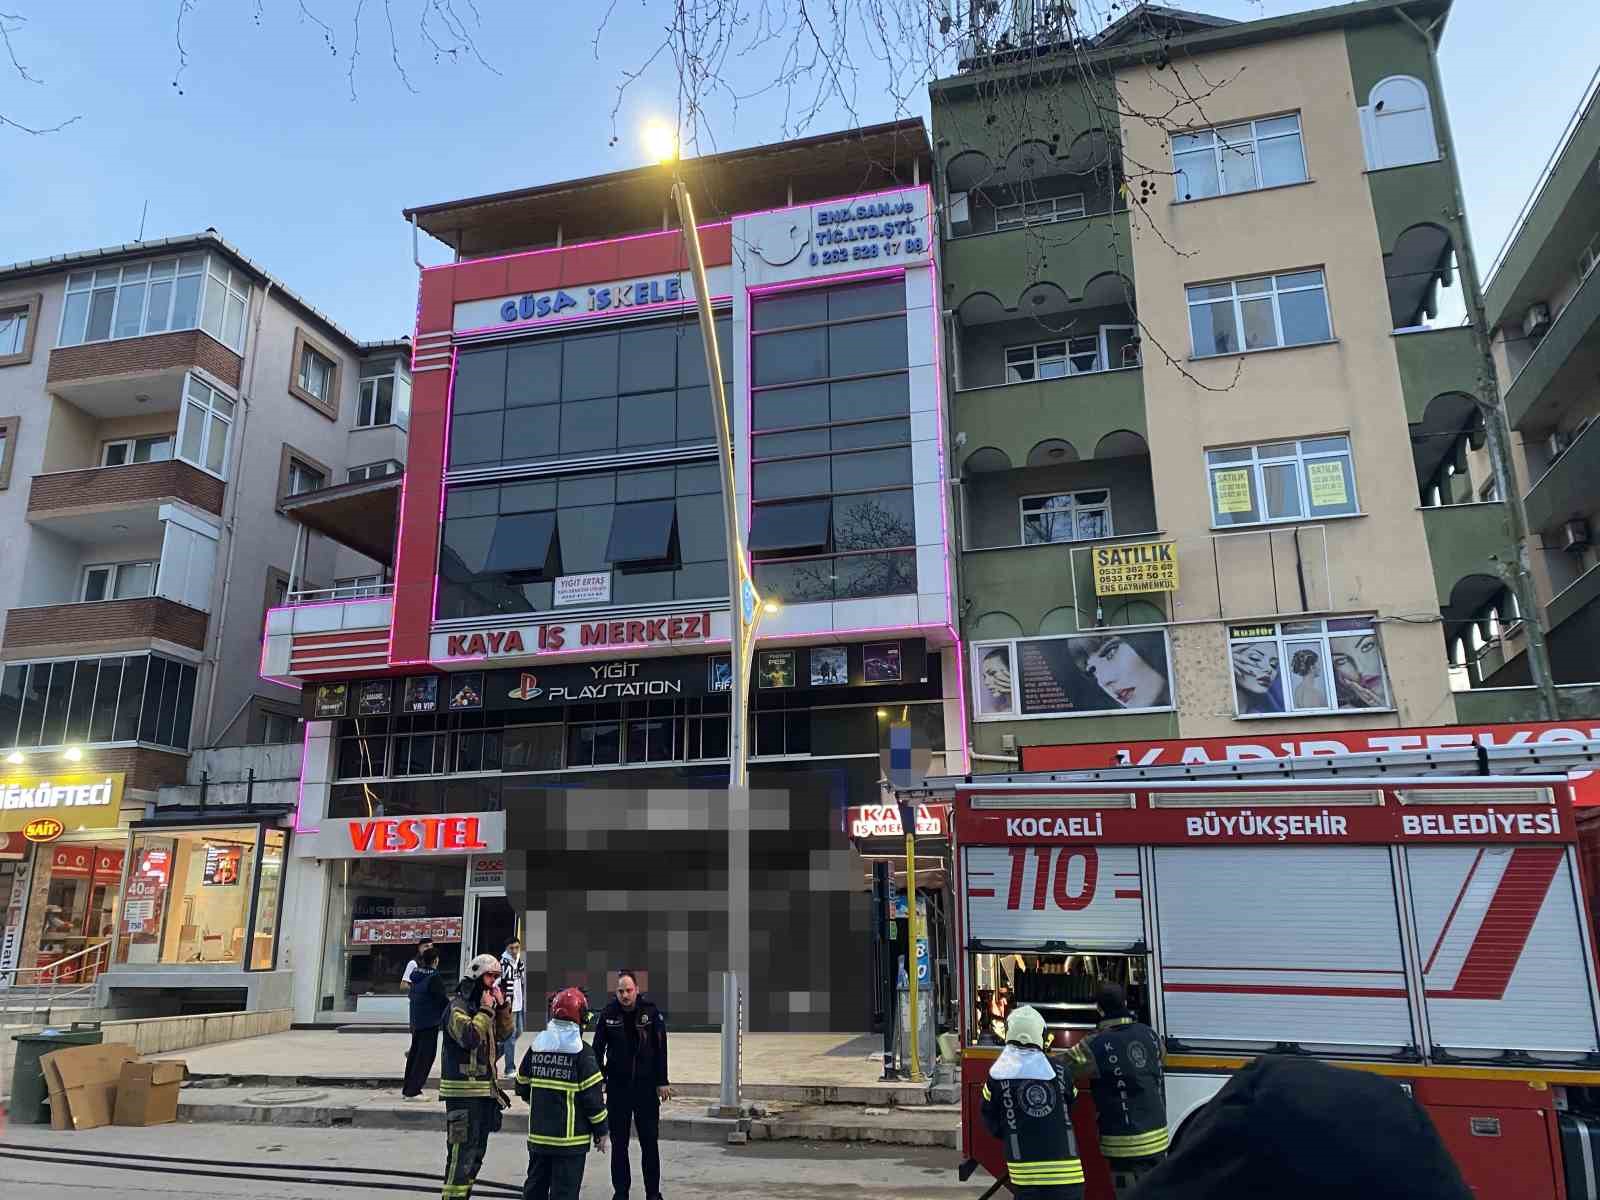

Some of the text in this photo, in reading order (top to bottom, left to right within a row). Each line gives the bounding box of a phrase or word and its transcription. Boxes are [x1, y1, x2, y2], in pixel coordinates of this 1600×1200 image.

[809, 252, 819, 267] 0
[822, 247, 848, 265] 262
[884, 240, 902, 256] 17
[500, 290, 577, 322] GÜSA
[1098, 543, 1172, 566] SATILIK
[447, 630, 524, 656] KAYA
[580, 610, 711, 646] MERKEZİ
[591, 661, 640, 679] YİĞİT
[549, 679, 681, 700] PLAYSTATION
[349, 817, 487, 853] VESTEL
[1007, 809, 1561, 841] KOCAELİ BÜYÜKŞEHİR BELEDİYESİ
[1007, 846, 1099, 911] 110
